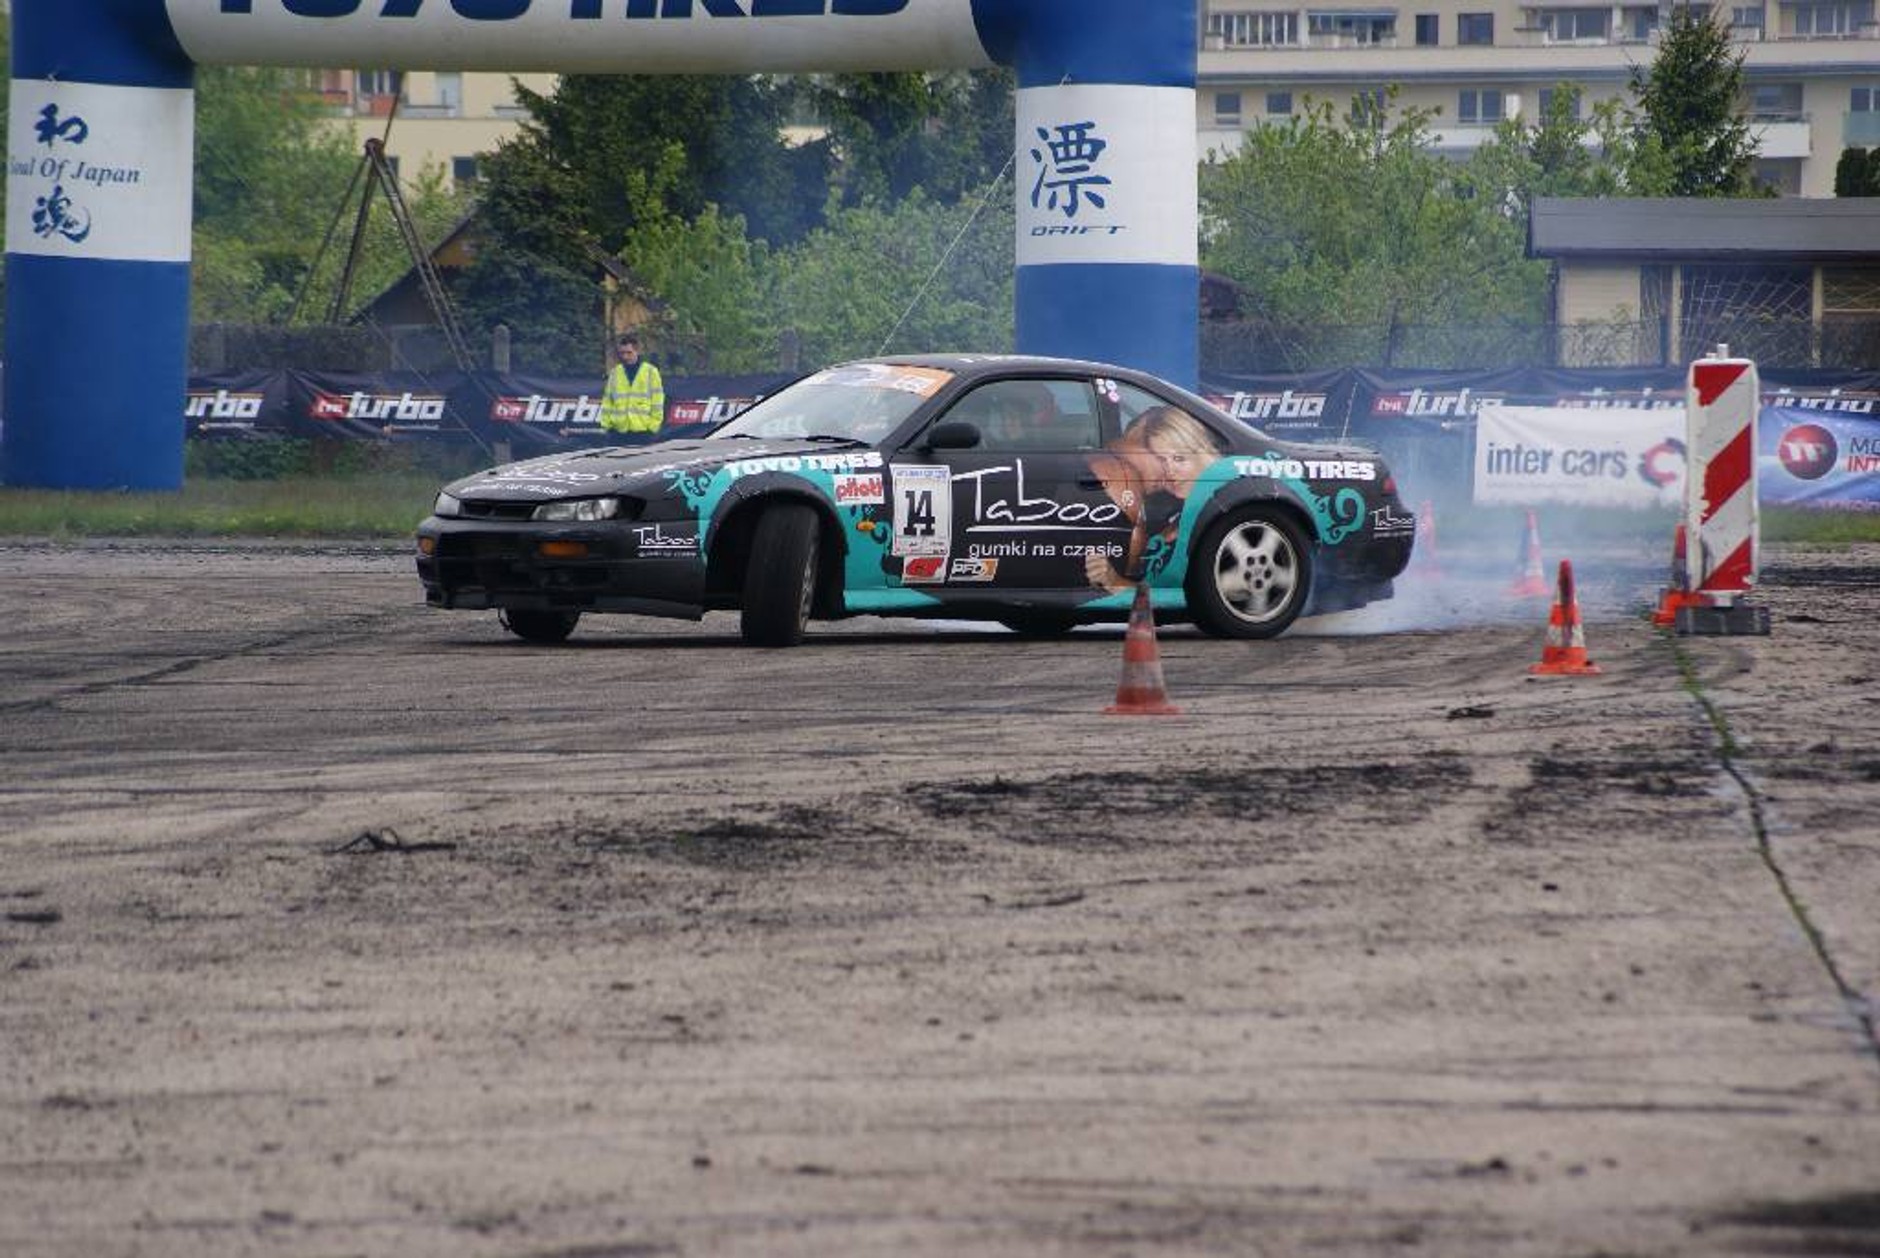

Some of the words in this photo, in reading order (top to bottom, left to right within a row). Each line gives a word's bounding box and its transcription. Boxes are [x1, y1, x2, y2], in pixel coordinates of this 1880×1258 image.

[40, 157, 69, 181] Of
[71, 161, 141, 187] Japan
[1030, 121, 1111, 218] 漂
[1031, 225, 1127, 236] DRIFT
[723, 456, 801, 480] TOYO
[801, 451, 884, 470] TIRES
[1234, 460, 1304, 480] TOYO
[1304, 460, 1376, 481] TIRES
[1486, 442, 1553, 475] inter
[1561, 449, 1627, 479] cars
[951, 457, 1121, 523] Taboo
[903, 490, 936, 536] 14
[968, 541, 1027, 559] gumki
[1032, 544, 1056, 557] na
[1062, 541, 1124, 557] czasie
